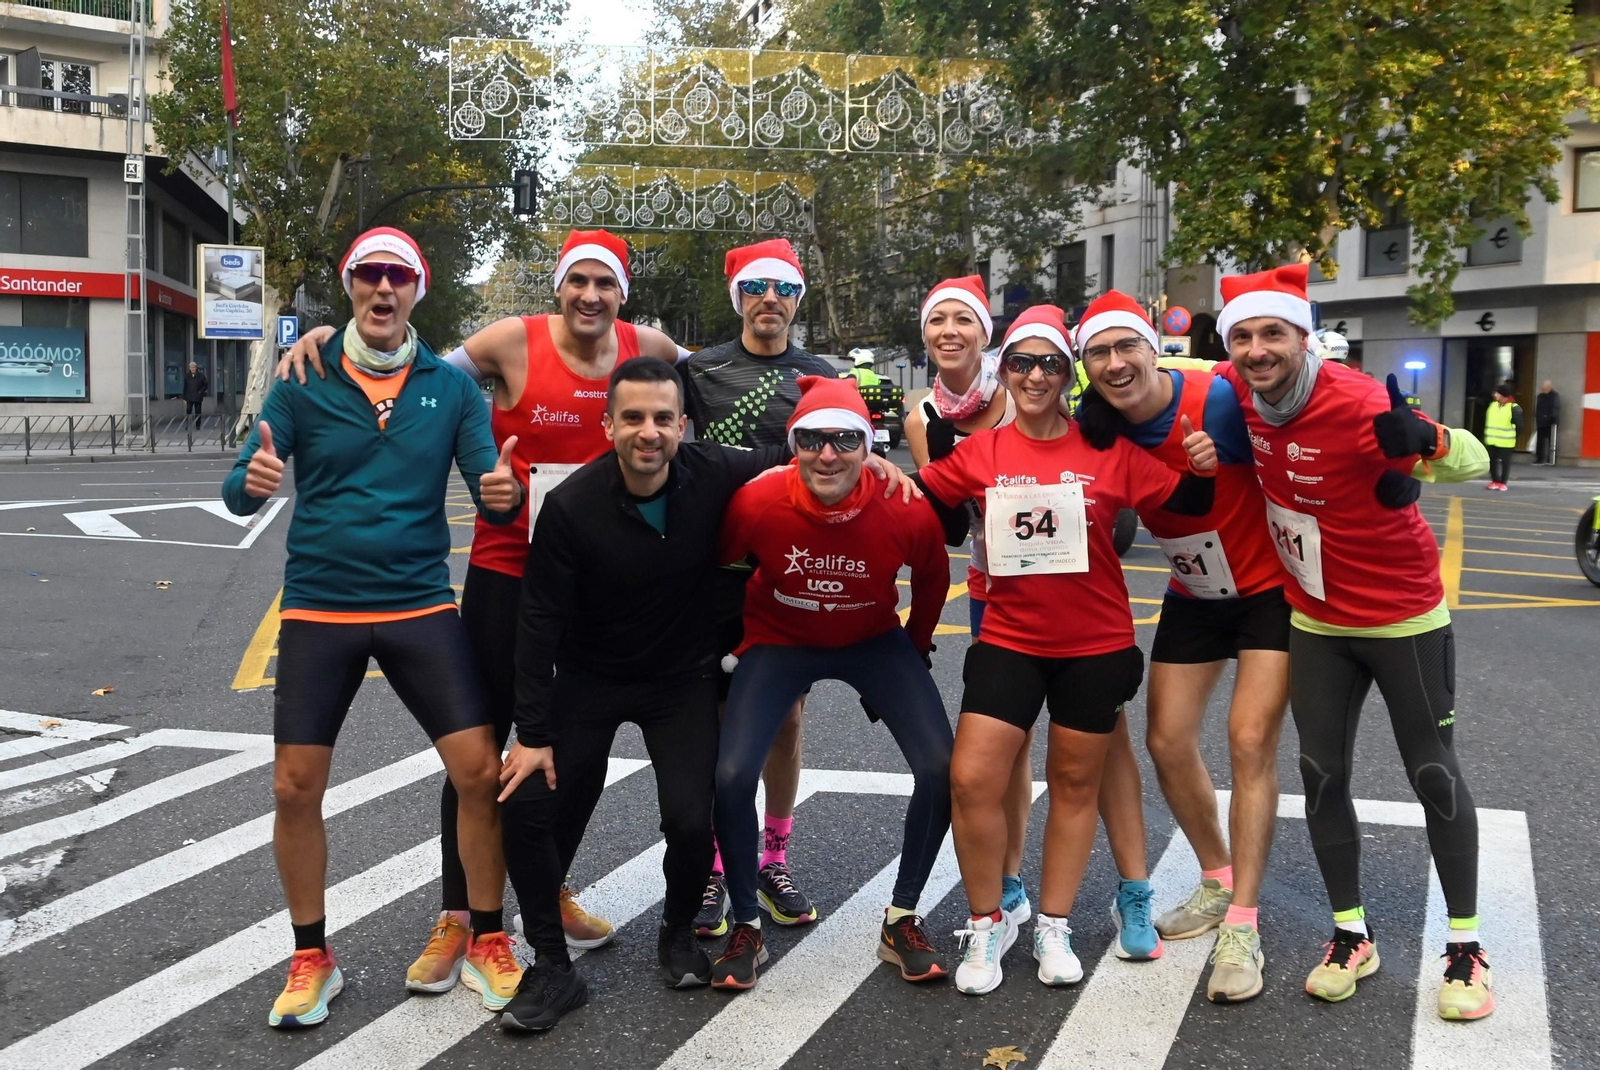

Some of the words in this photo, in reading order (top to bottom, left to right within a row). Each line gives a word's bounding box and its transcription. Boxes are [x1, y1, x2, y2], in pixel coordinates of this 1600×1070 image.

[0, 275, 82, 293] Santander
[282, 320, 294, 343] P
[543, 411, 580, 423] califas
[1004, 475, 1037, 486] califas
[1015, 509, 1057, 541] 54
[804, 555, 866, 573] califas
[1173, 554, 1208, 575] 61
[807, 579, 844, 593] UCO
